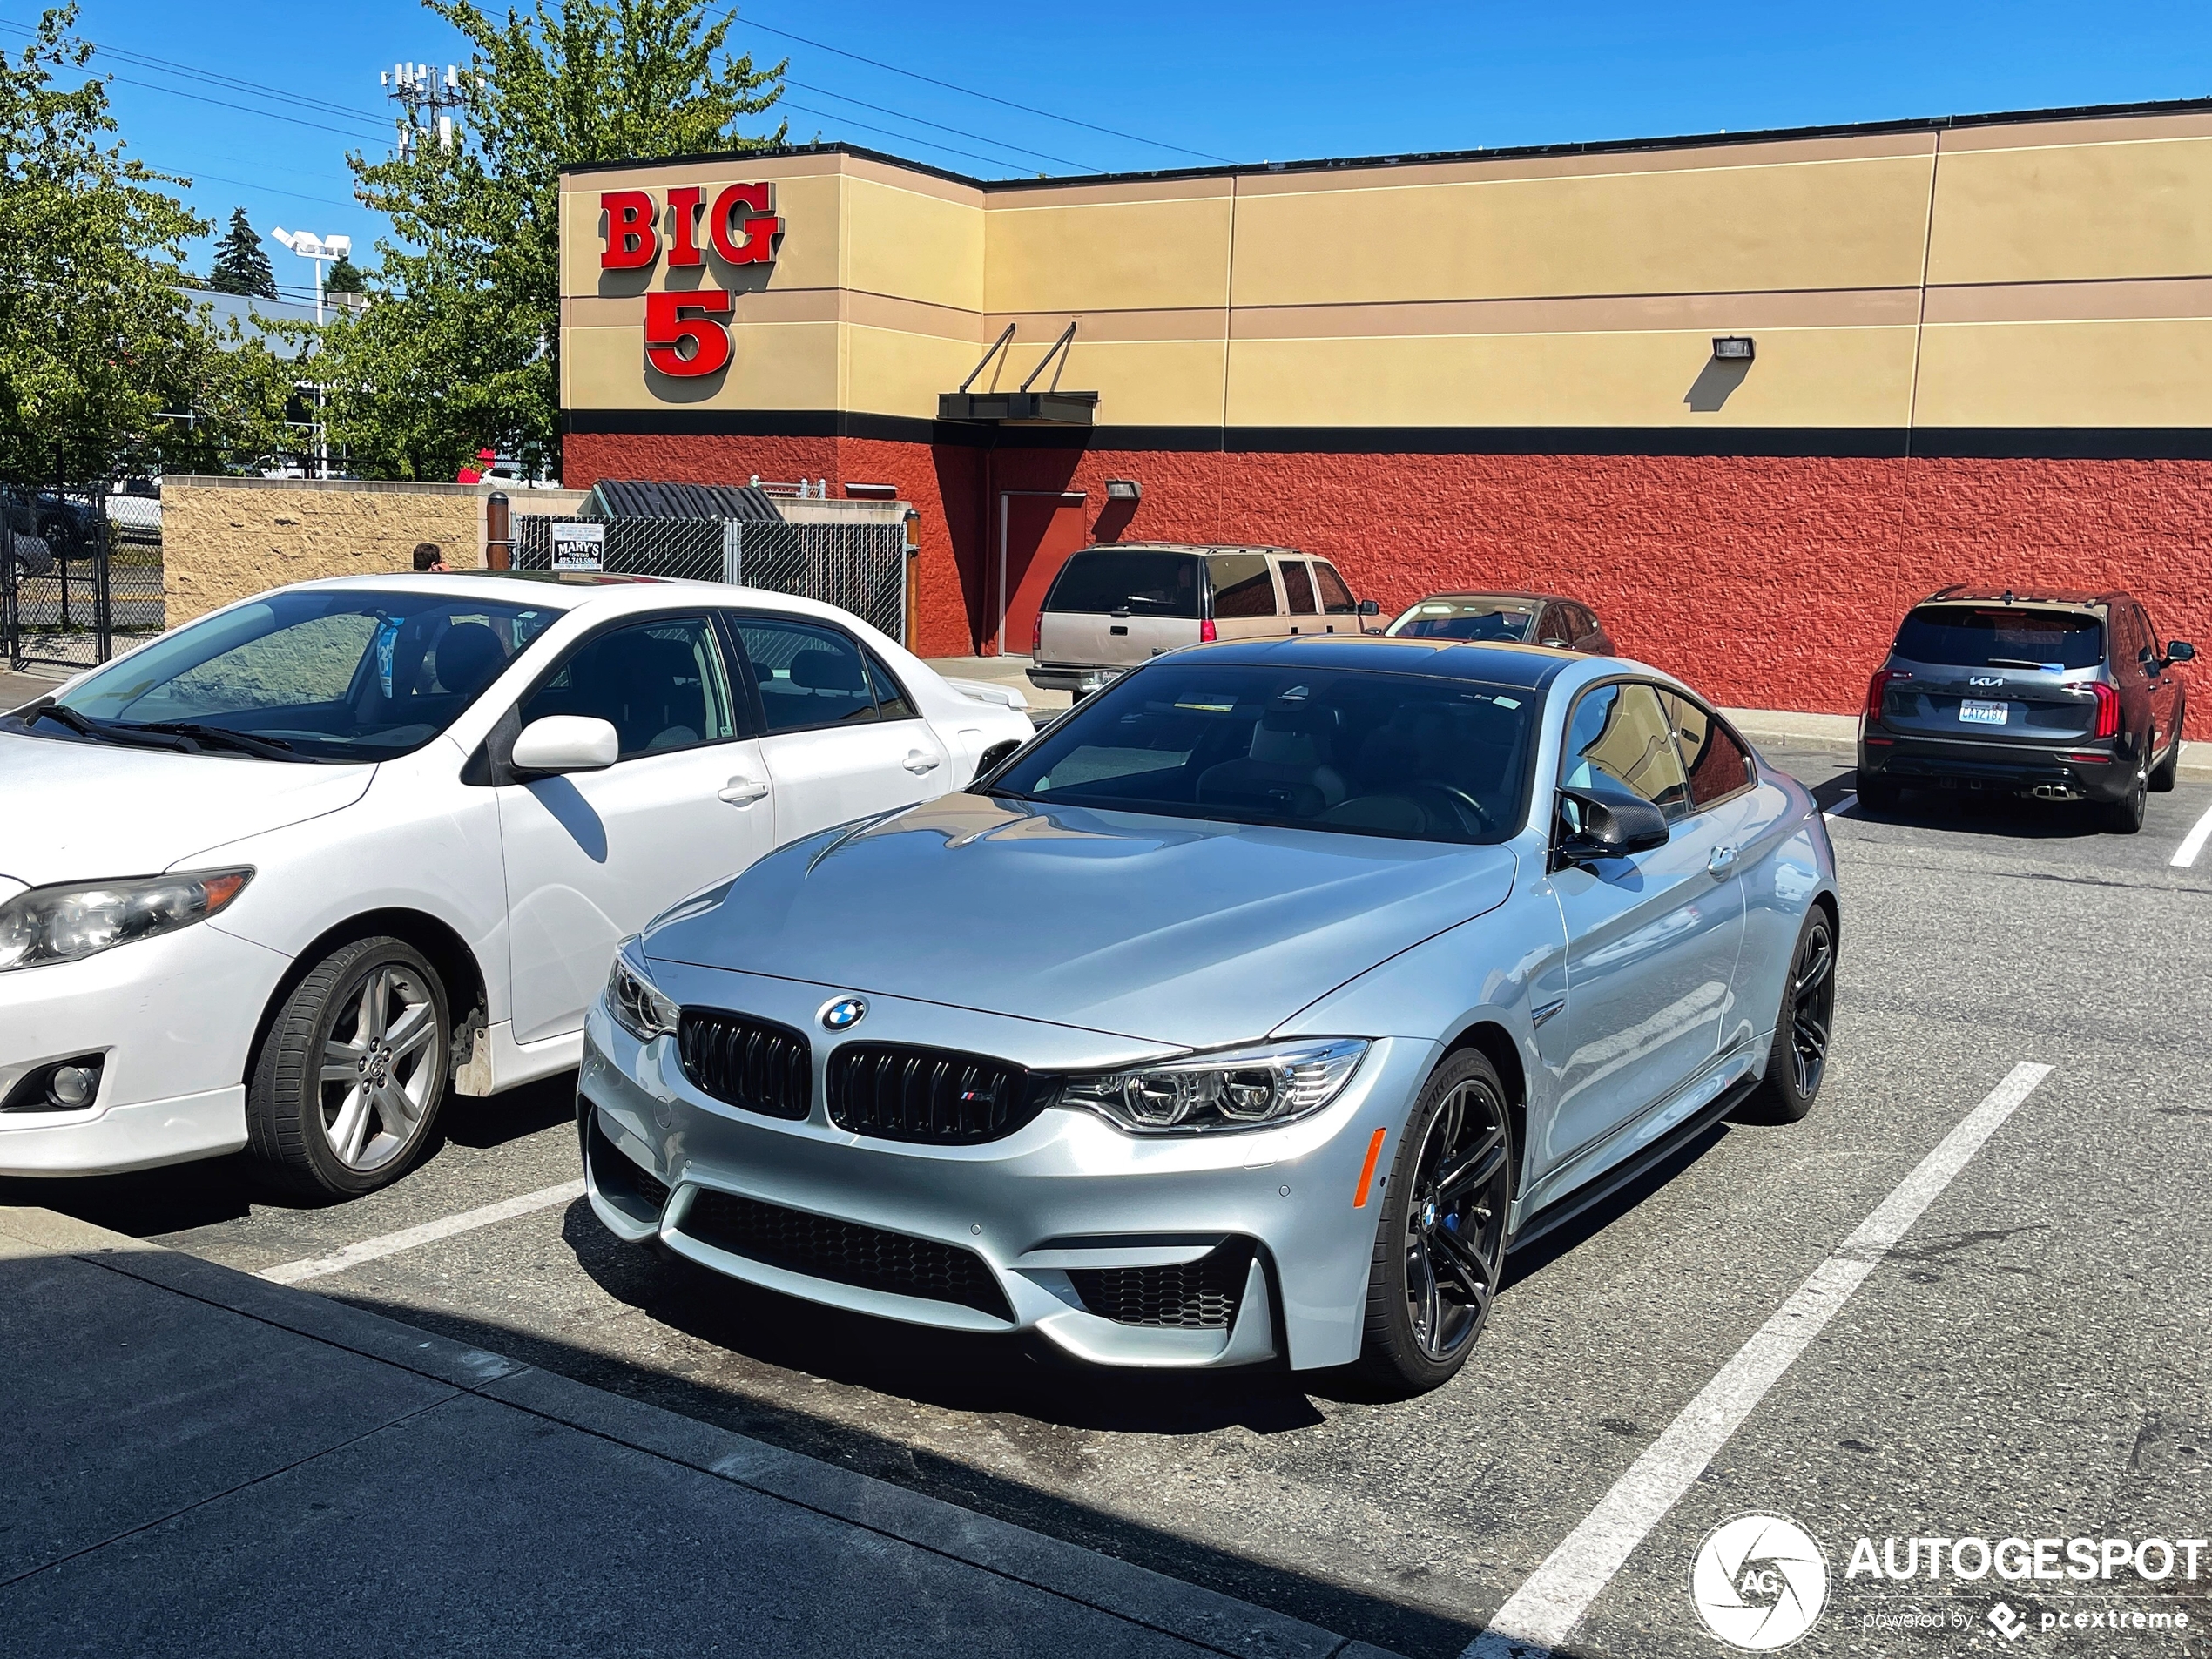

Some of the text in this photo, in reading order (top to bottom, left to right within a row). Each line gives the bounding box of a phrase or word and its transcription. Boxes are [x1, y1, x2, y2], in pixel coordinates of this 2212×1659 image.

[601, 181, 785, 269] BIG
[645, 290, 735, 377] 5
[557, 541, 599, 556] MARY'S
